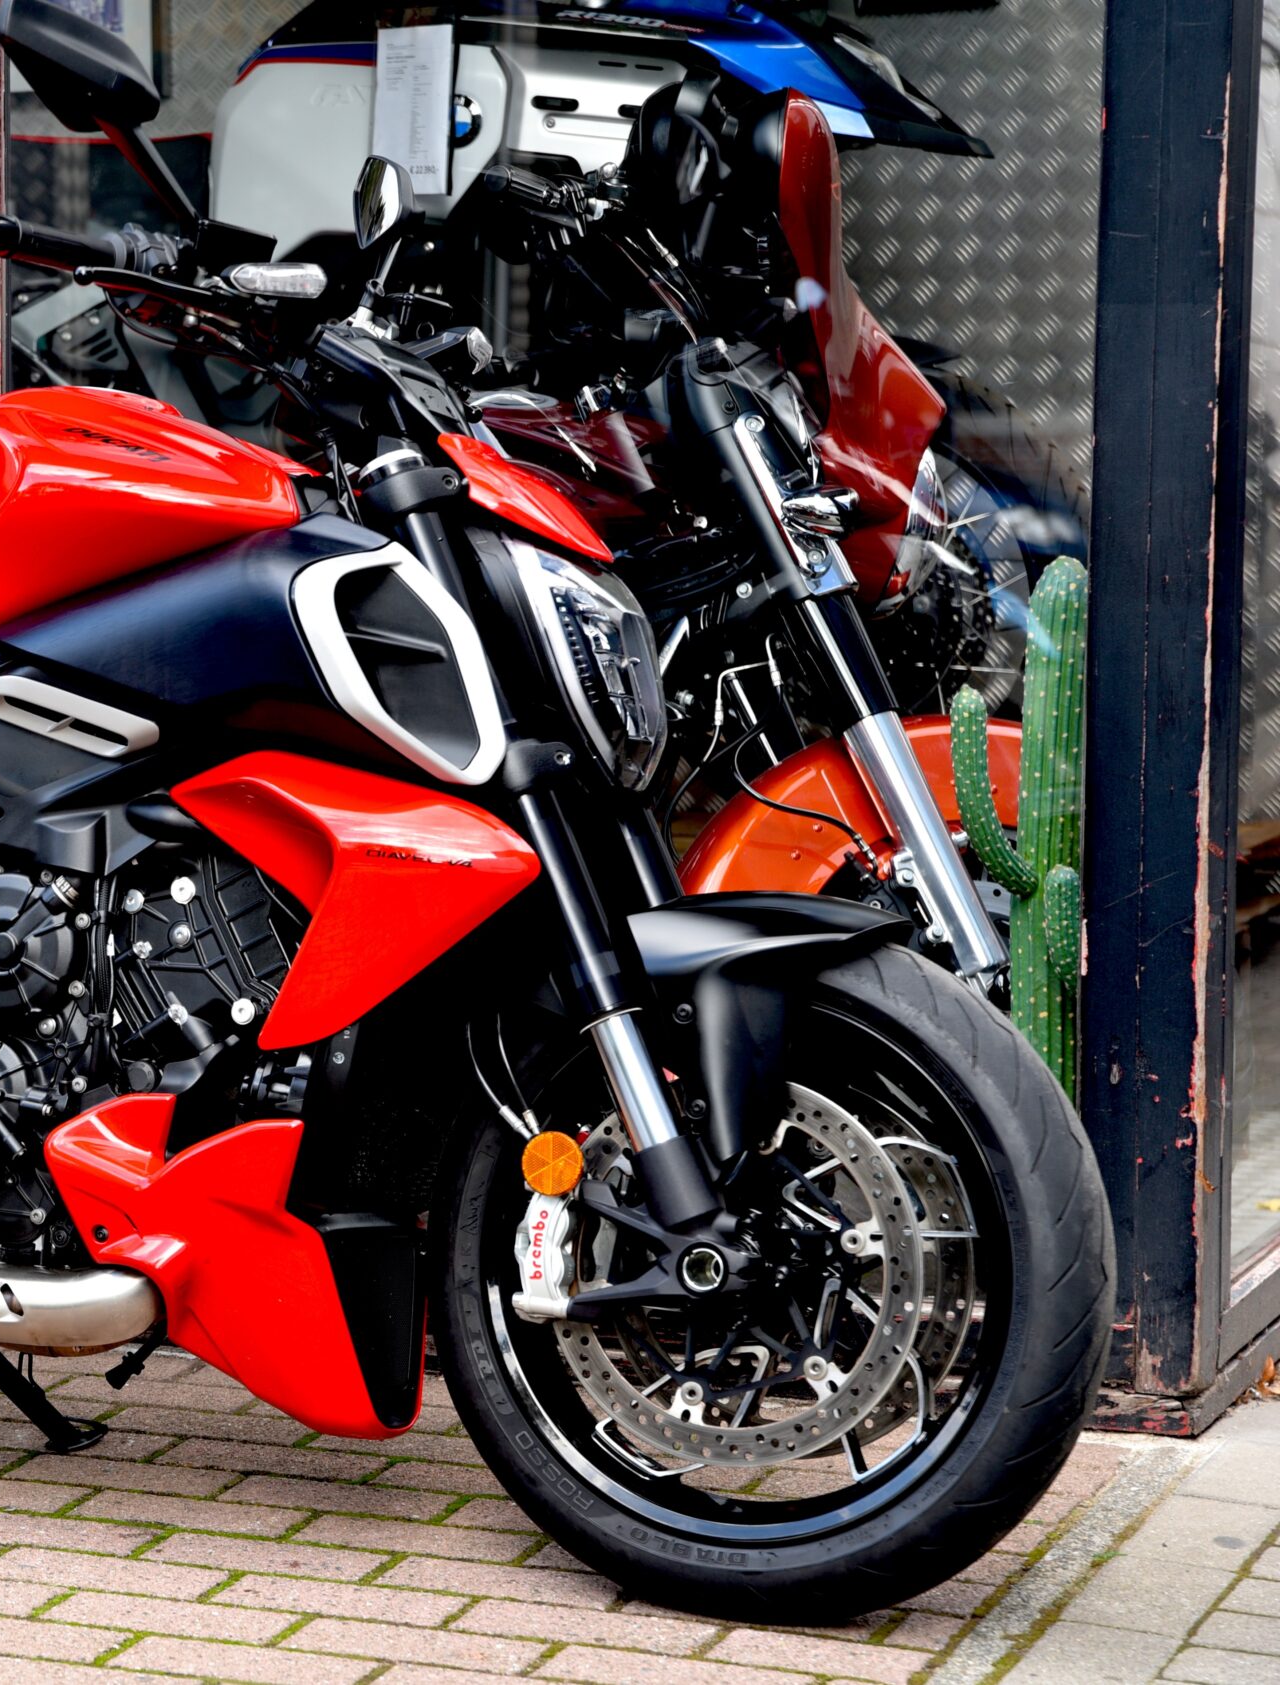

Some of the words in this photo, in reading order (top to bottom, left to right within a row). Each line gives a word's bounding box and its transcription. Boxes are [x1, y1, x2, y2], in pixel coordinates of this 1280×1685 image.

[63, 427, 171, 462] DUCATI
[366, 849, 444, 864] DIAVEL
[449, 859, 472, 868] V4
[529, 1210, 549, 1280] brembo
[514, 1429, 594, 1512] ROSSO
[630, 1525, 747, 1567] DIABLO
